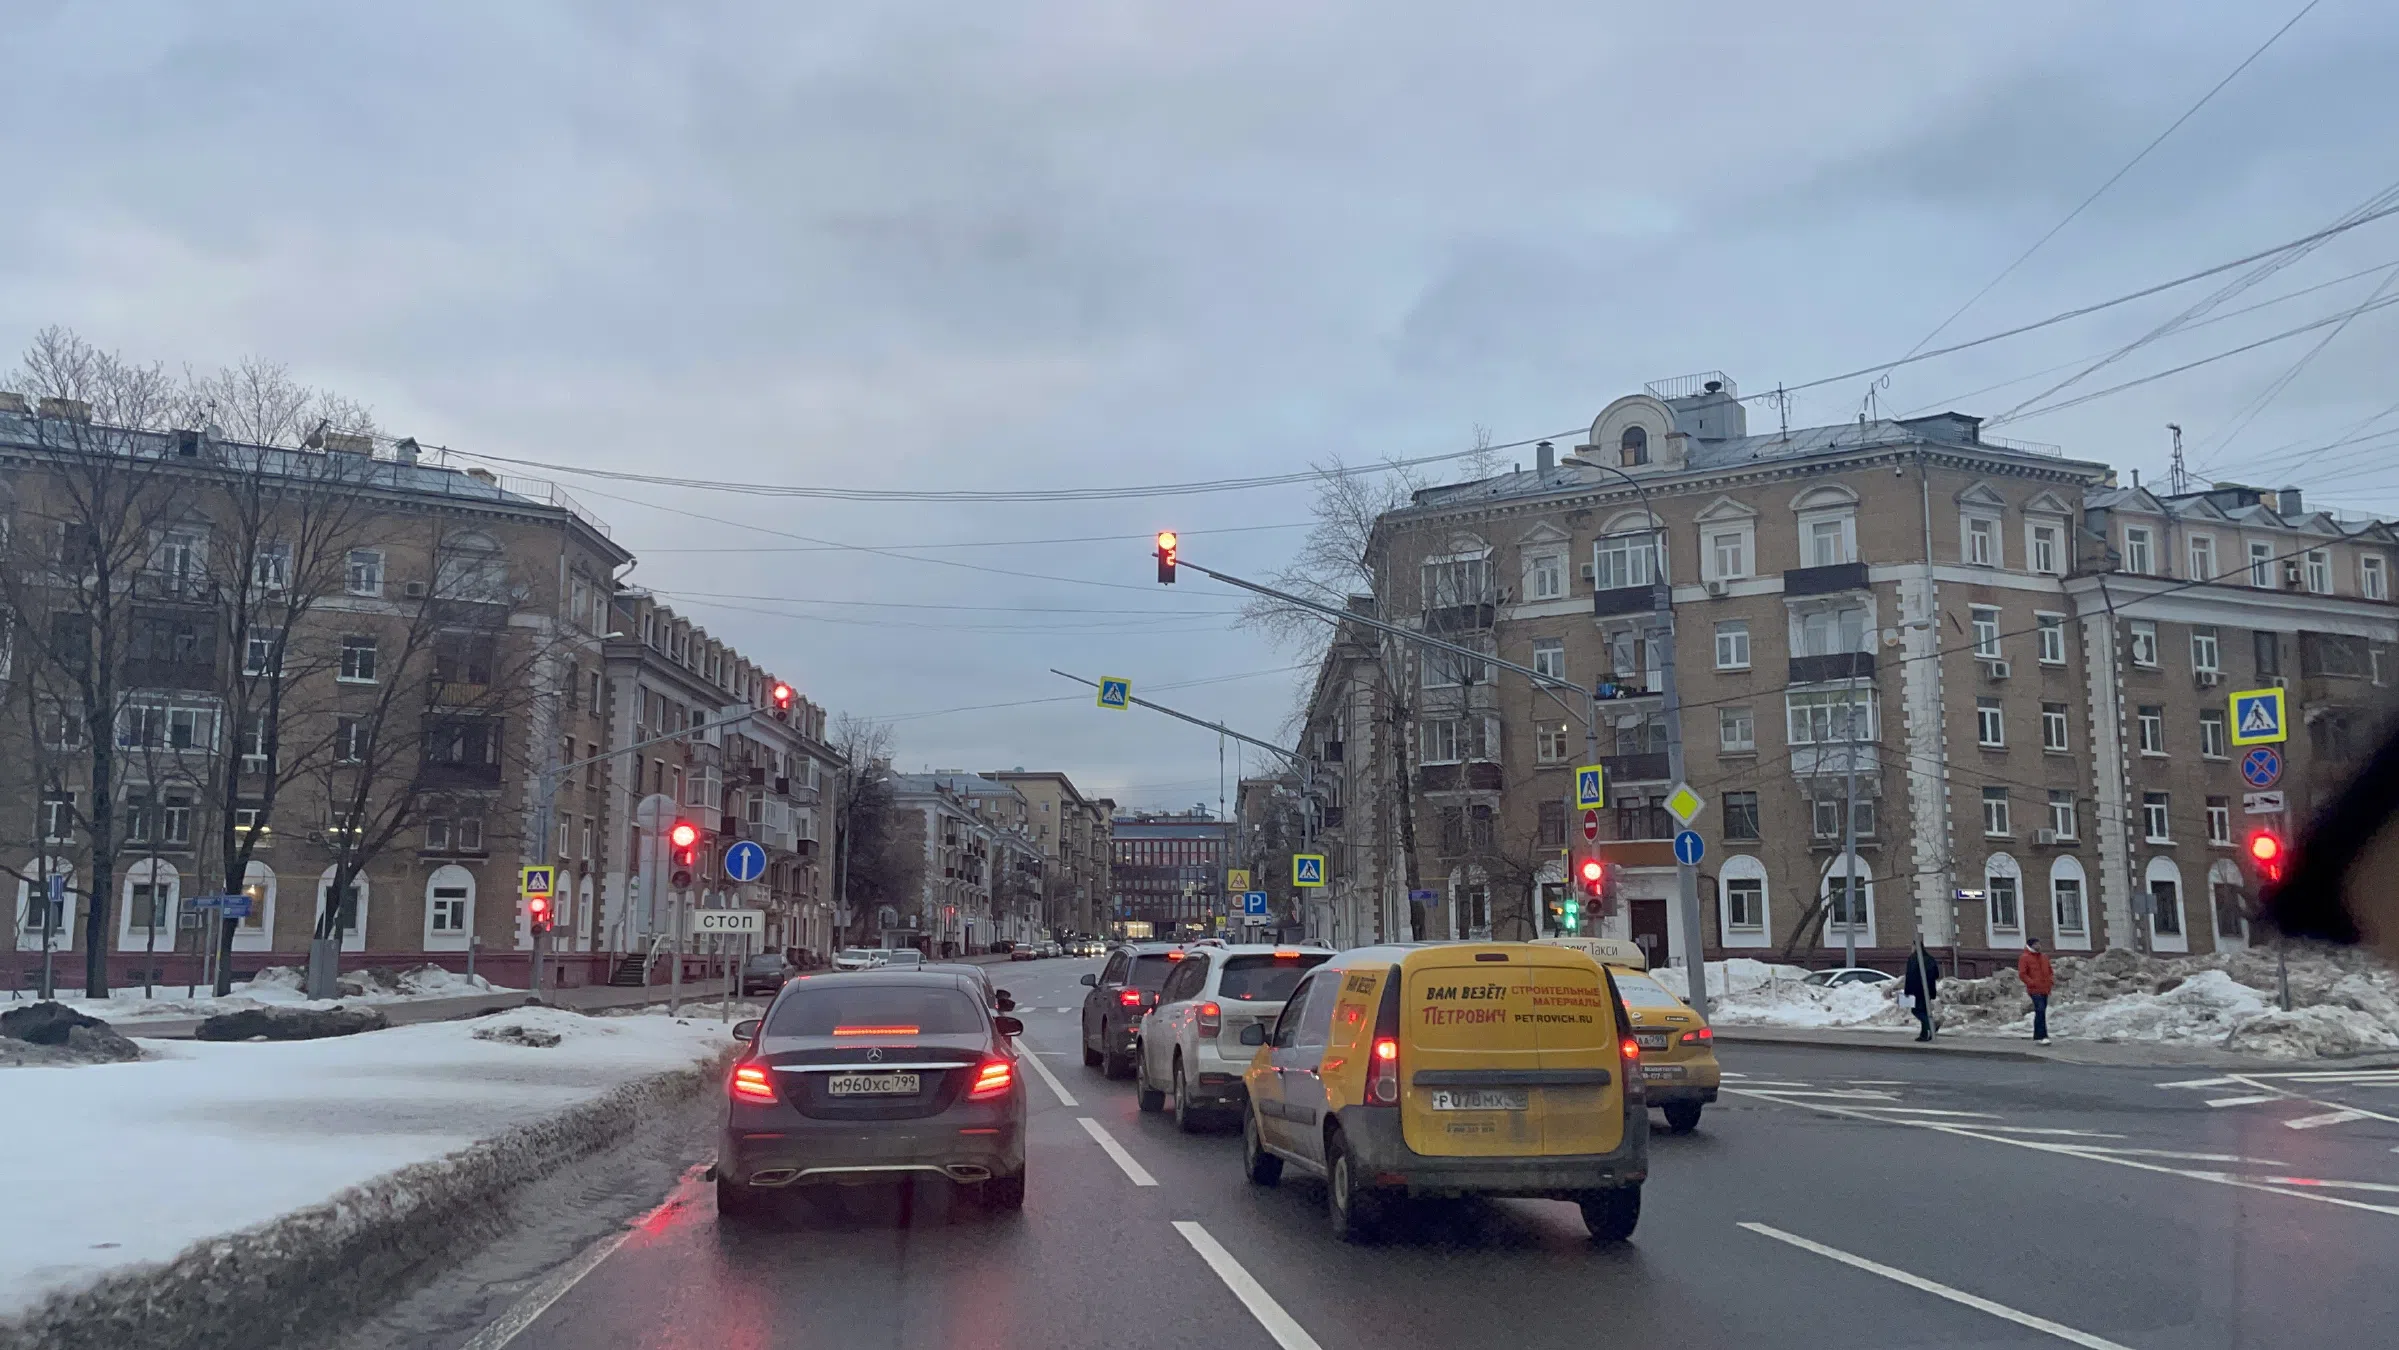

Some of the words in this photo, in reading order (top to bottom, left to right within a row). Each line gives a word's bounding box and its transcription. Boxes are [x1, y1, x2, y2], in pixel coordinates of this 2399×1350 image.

[703, 915, 752, 928] СТОП
[1589, 941, 1618, 956] Такси
[1426, 986, 1457, 1000] ВАМ
[1461, 983, 1507, 1000] ВЕЗЁТ!
[1511, 985, 1600, 996] СТРОИТЕЛЬНЫЕ
[1533, 997, 1601, 1008] МАТЕРИАЛЫ
[1514, 1014, 1593, 1024] PETROVICH.RU
